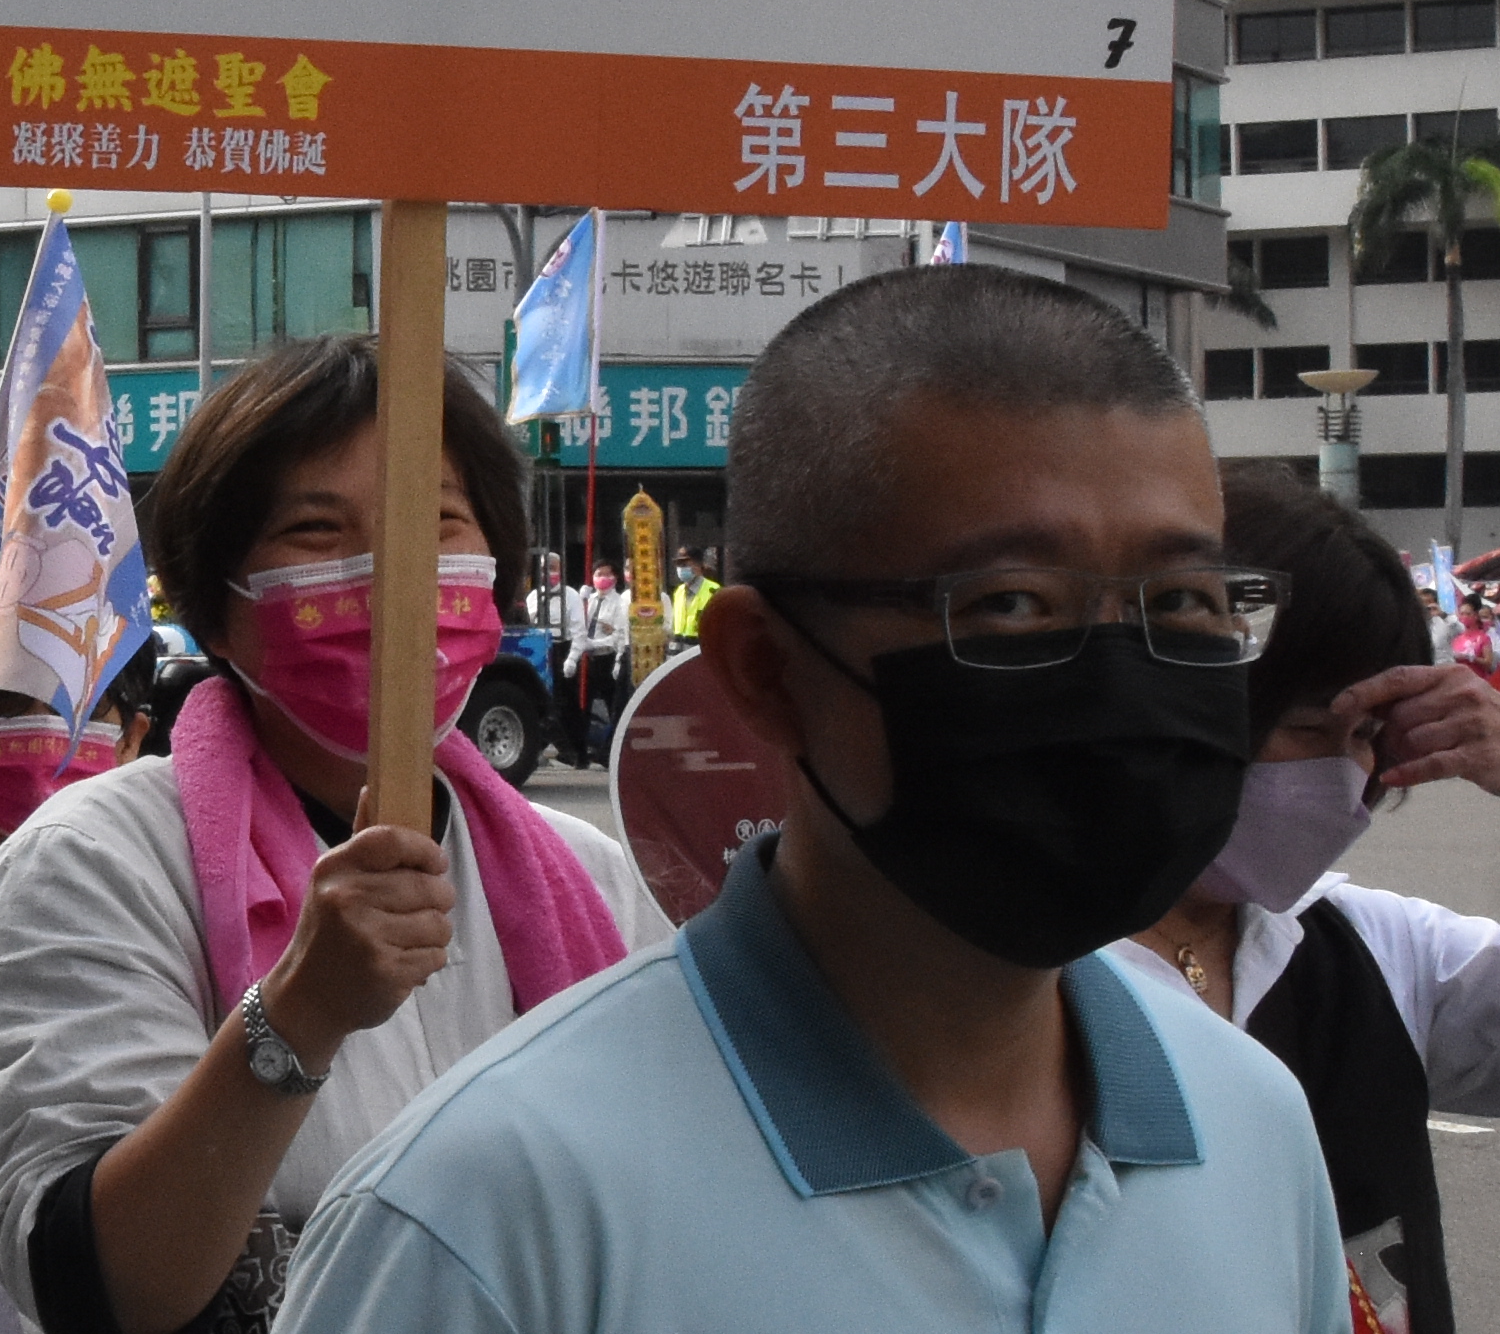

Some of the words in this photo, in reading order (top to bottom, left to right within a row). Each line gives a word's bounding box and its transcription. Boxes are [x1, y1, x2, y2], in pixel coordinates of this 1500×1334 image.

[1104, 17, 1139, 71] 7
[12, 119, 161, 174] 凝聚善力
[183, 127, 328, 178] 恭賀佛誕
[732, 82, 1079, 206] 第三大隊
